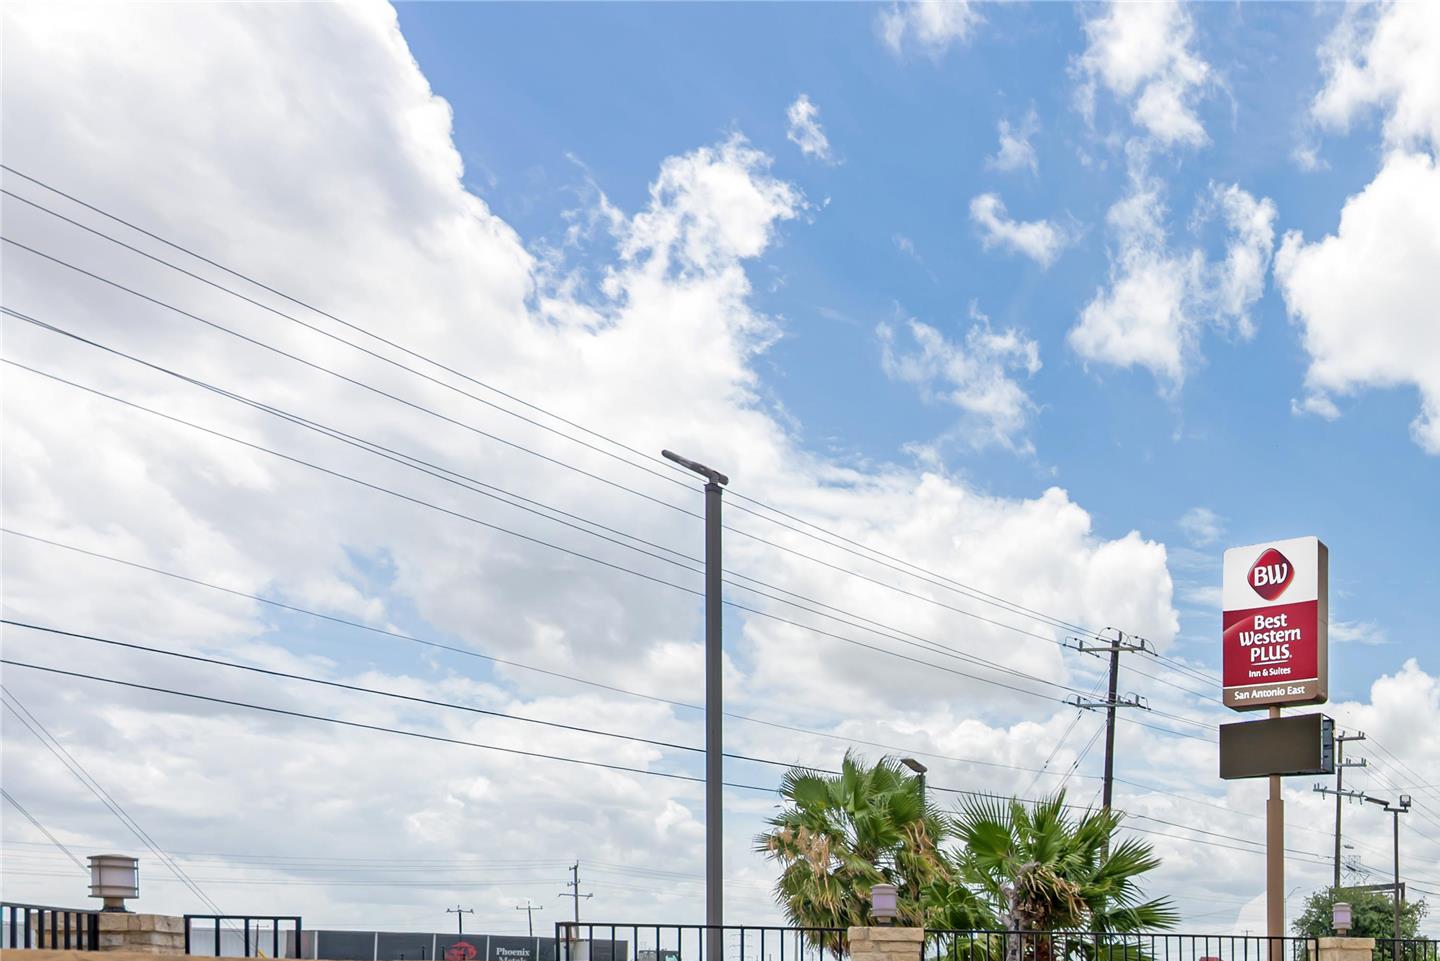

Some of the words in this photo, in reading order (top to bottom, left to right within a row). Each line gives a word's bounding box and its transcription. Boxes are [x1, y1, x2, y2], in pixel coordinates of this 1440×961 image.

[1254, 562, 1288, 587] BW
[1254, 613, 1288, 630] Best
[1239, 628, 1302, 647] Western
[1250, 644, 1290, 663] PLUS
[1248, 670, 1261, 678] Inn
[1262, 668, 1269, 677] &
[1269, 666, 1292, 677] Suites
[1234, 691, 1249, 700] San
[1251, 687, 1286, 699] Antonio
[1287, 685, 1305, 695] East
[496, 947, 530, 957] Phoenix
